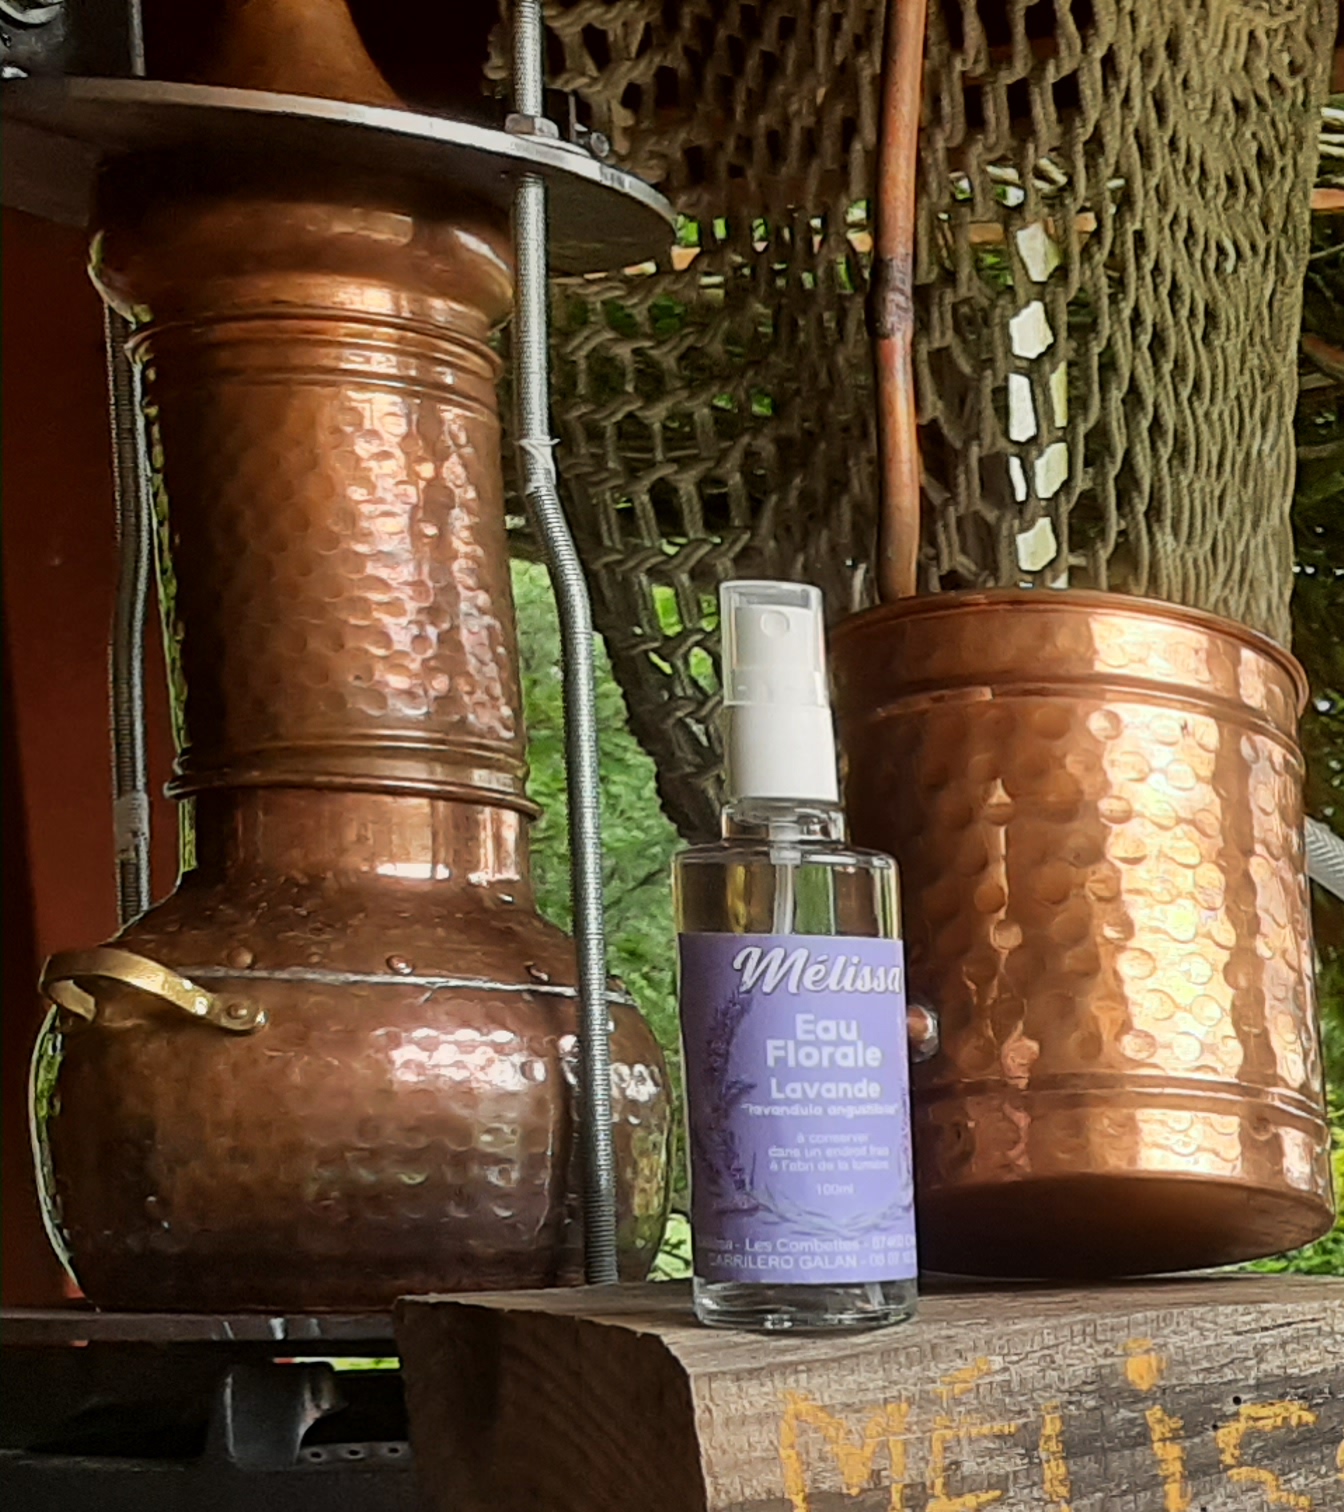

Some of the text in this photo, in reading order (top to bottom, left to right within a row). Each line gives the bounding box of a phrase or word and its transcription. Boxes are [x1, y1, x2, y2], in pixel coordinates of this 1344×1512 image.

[795, 1013, 858, 1041] Eau
[766, 1041, 883, 1068] Florale
[770, 1078, 881, 1099] Lavande
[816, 1183, 854, 1196] 100ml
[745, 1239, 773, 1253] Les
[799, 1254, 858, 1270] GALAN
